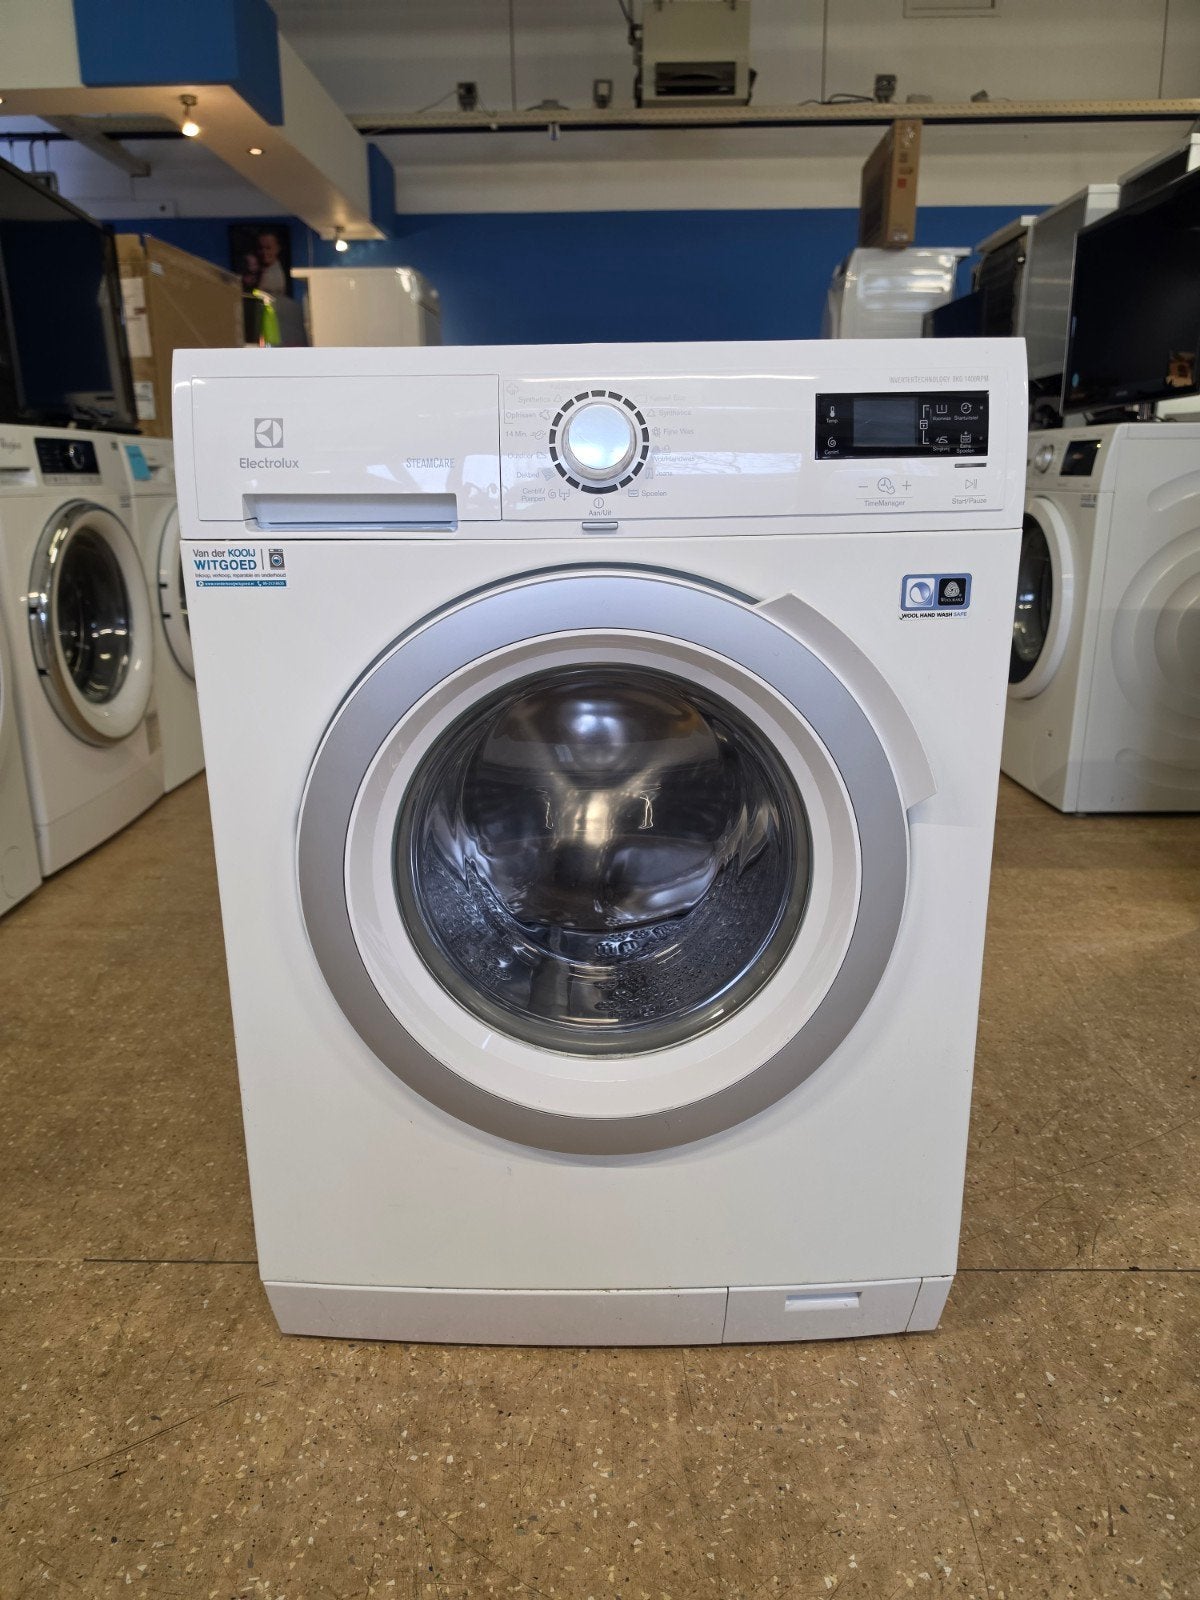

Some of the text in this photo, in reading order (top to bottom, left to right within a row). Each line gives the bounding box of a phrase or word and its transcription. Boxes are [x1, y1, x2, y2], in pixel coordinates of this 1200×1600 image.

[239, 457, 299, 469] Electrolux
[406, 457, 455, 468] STEAMCARE
[641, 489, 668, 498] Spoelen
[864, 500, 906, 508] TimeManager
[588, 509, 612, 517] Aan/Uit
[192, 548, 256, 557] Van der KOOIJ
[194, 560, 257, 570] WITGOED
